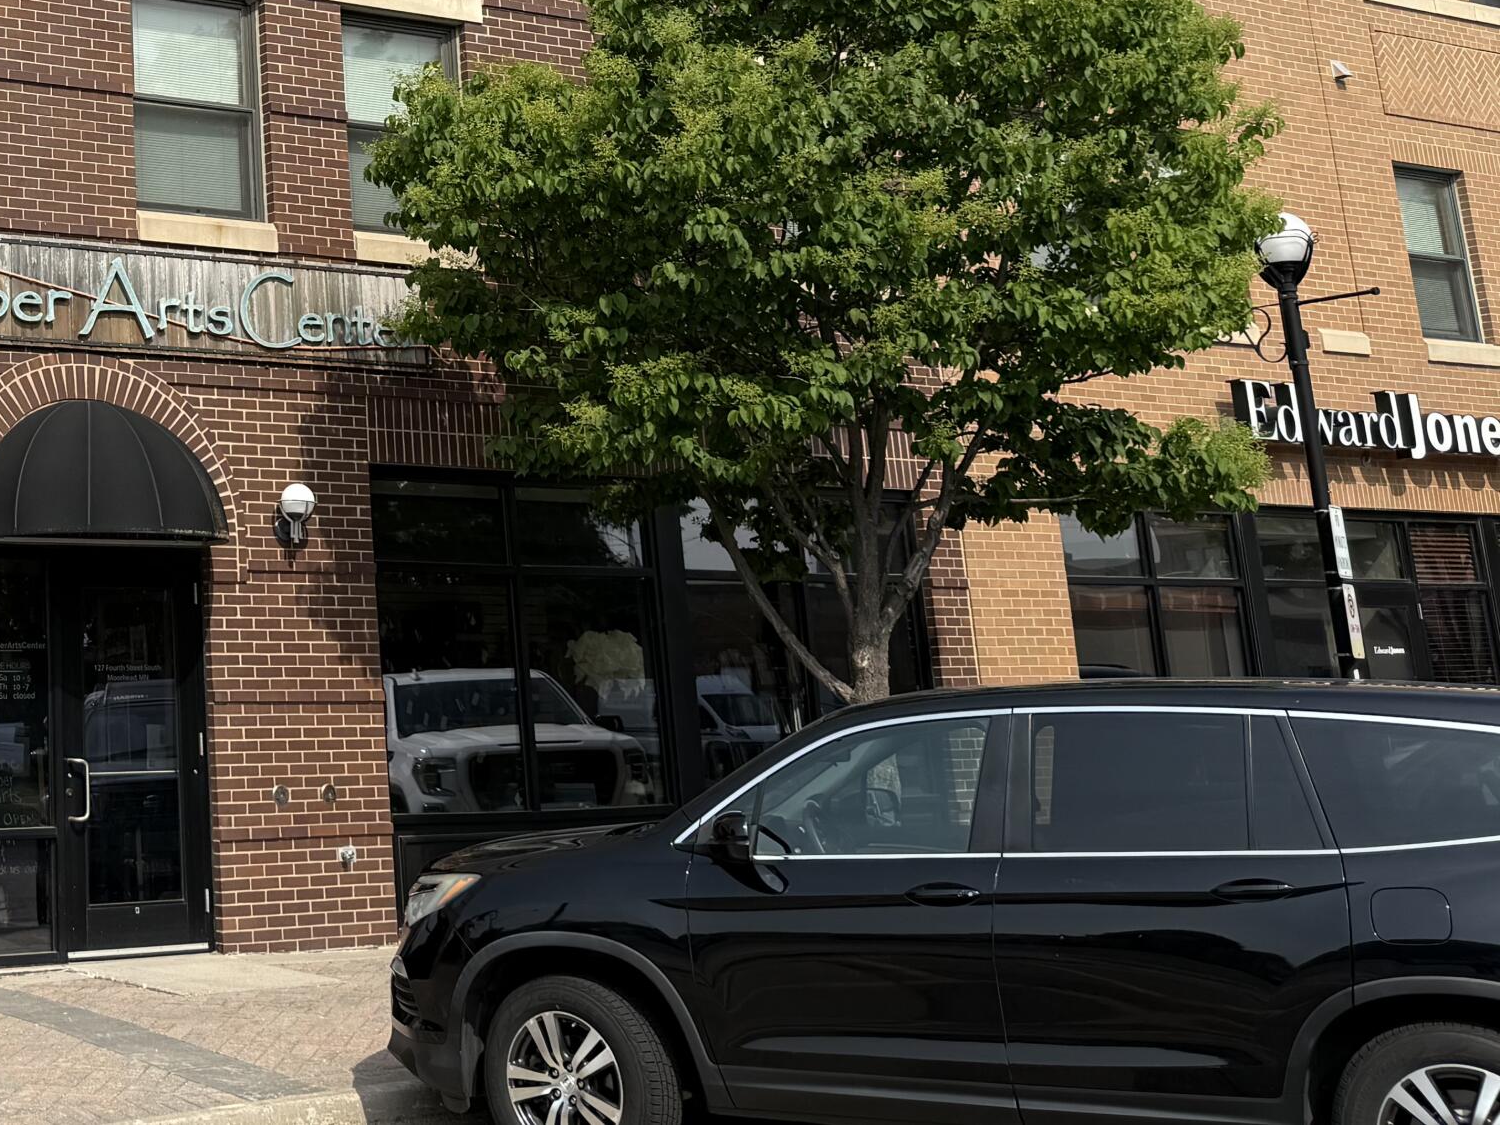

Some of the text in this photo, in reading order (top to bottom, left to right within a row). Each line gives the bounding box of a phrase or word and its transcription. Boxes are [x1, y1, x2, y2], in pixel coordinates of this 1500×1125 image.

[78, 257, 234, 339] Arts
[240, 272, 414, 349] Cente
[1407, 393, 1500, 460] Jone
